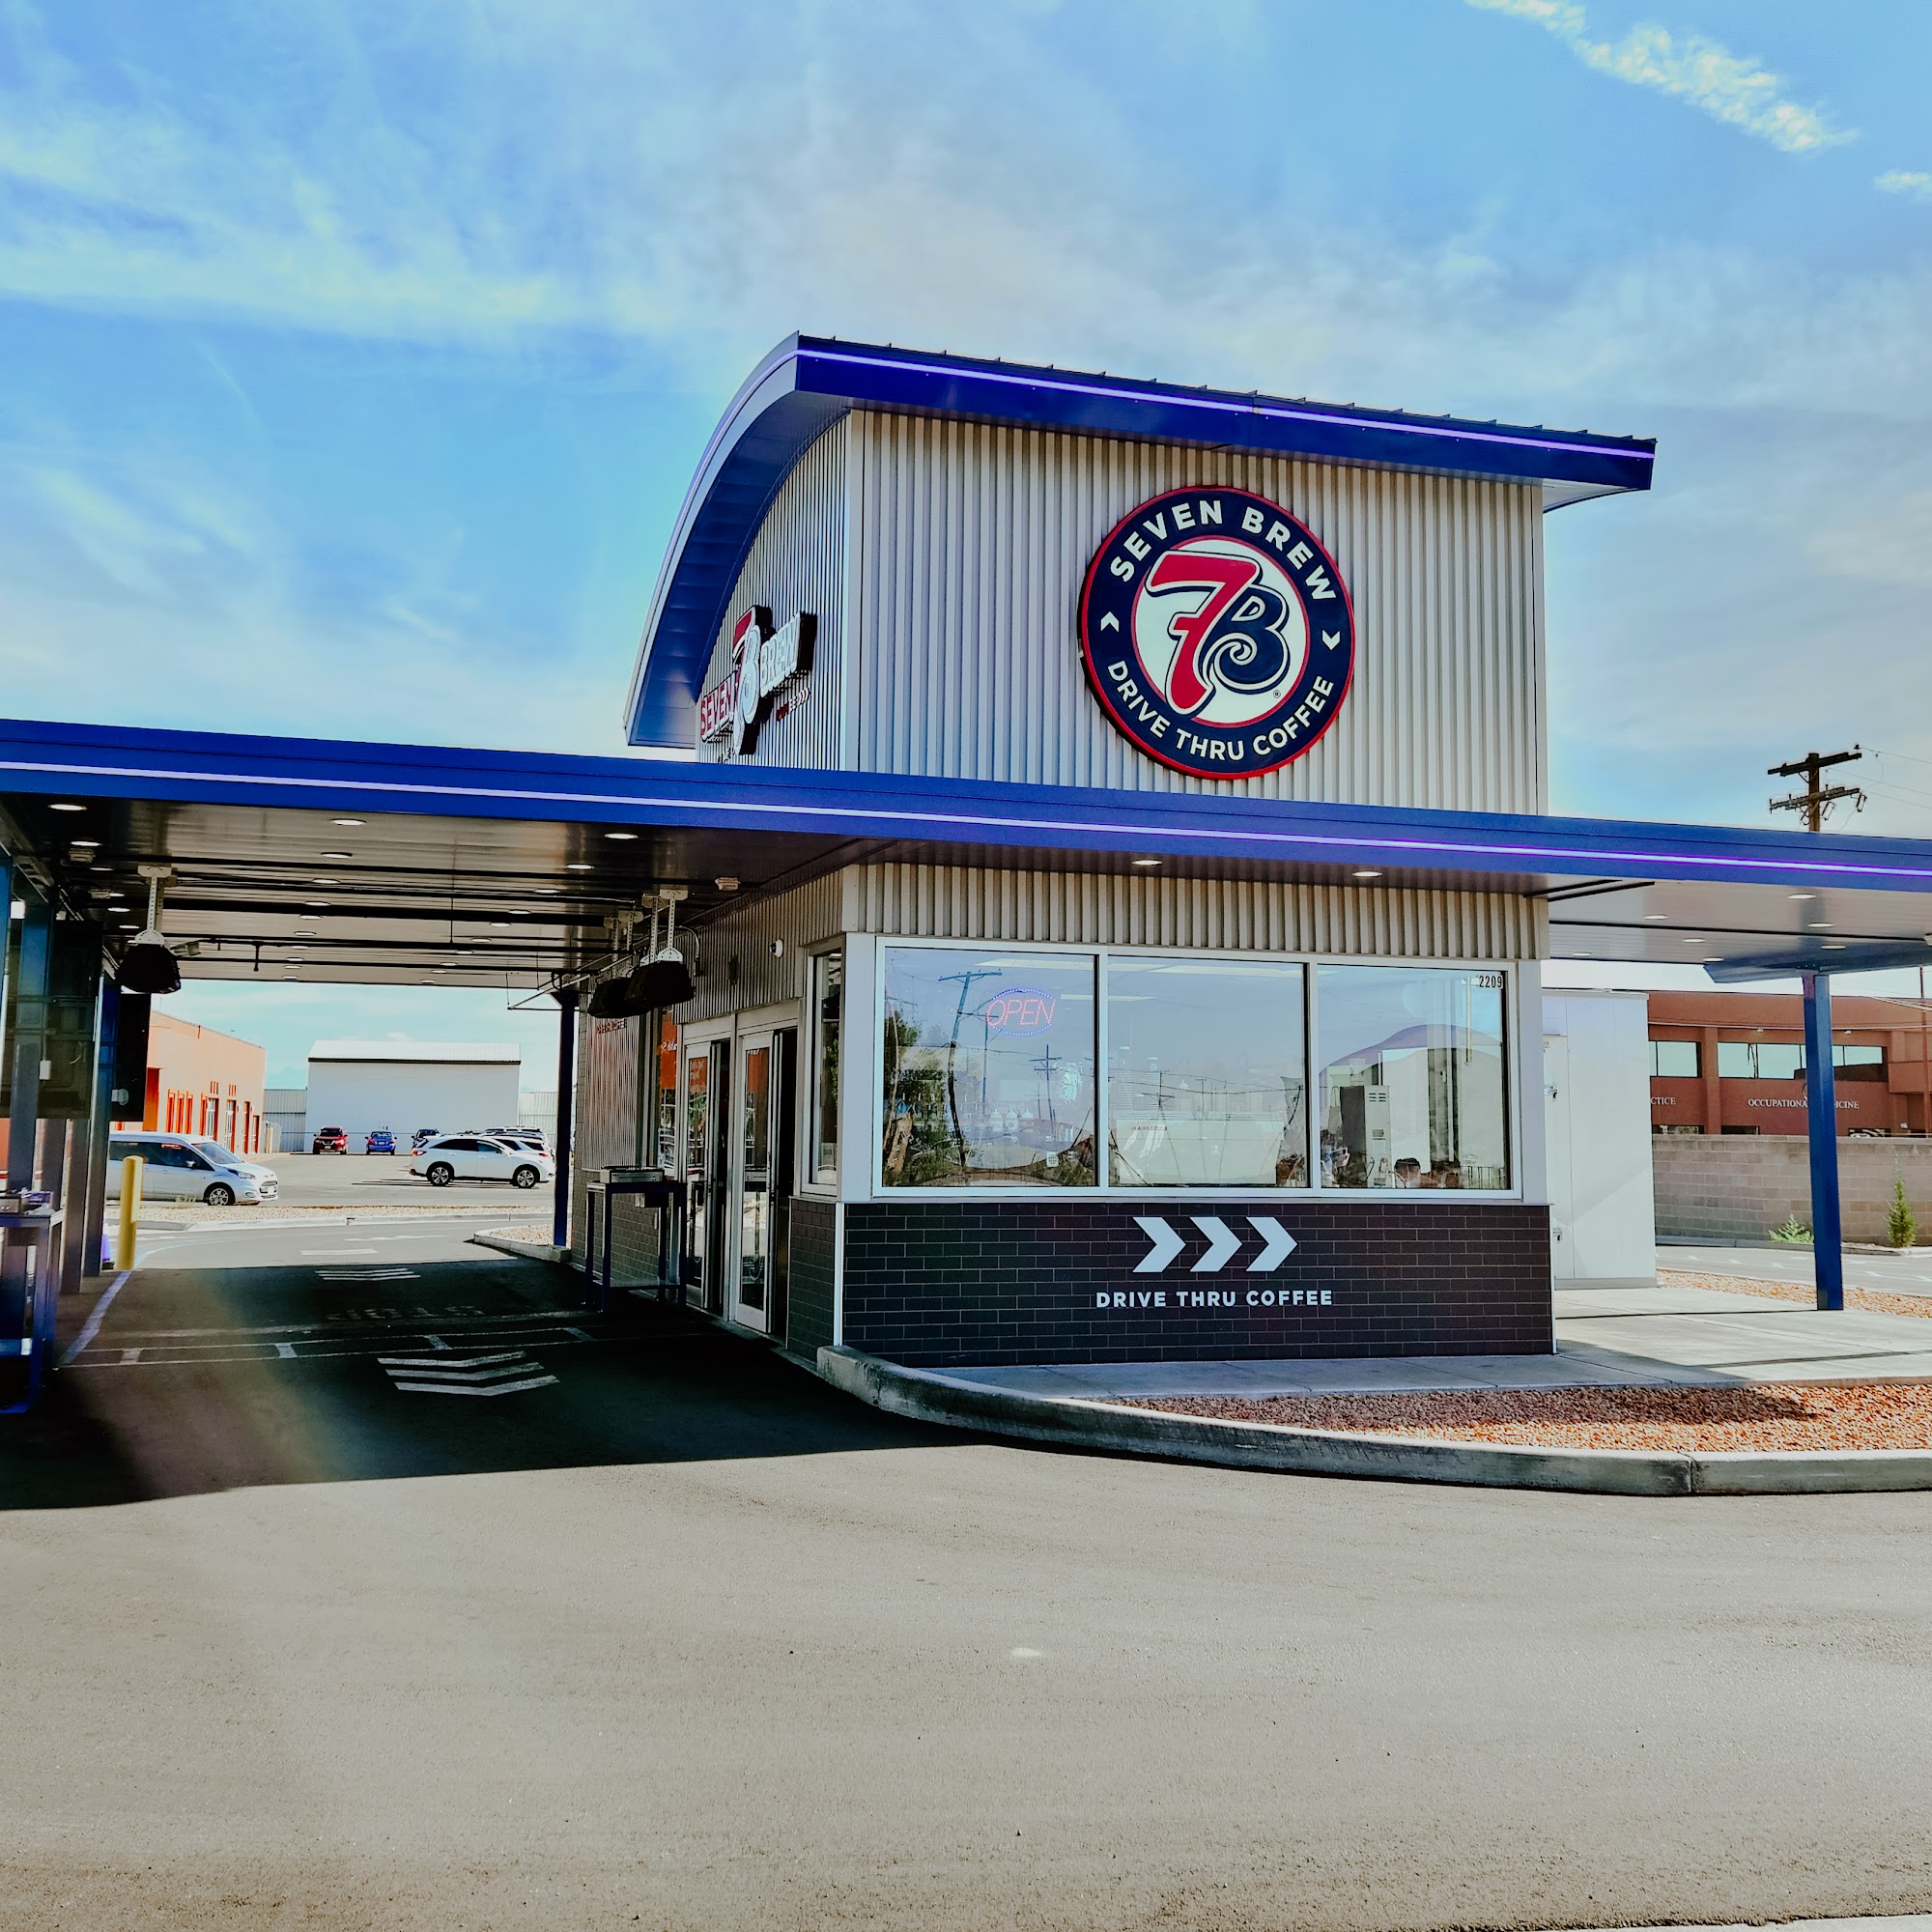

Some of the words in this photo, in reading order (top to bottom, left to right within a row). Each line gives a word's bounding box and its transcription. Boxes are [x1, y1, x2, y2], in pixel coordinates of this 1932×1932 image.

[1111, 499, 1223, 582] SEVEN
[1241, 506, 1337, 600] BREW
[700, 672, 735, 741] SEVEN
[759, 611, 800, 697] BREW
[1107, 661, 1171, 738] DRIVE
[1175, 727, 1245, 762] THRU
[1253, 675, 1335, 755] COFFEE
[1479, 975, 1503, 988] 2209
[985, 998, 1057, 1027] OPEN
[1650, 1096, 1676, 1105] CTICE
[1747, 1098, 1808, 1108] OCCUPATIONA
[1834, 1100, 1861, 1109] ICINE
[1096, 1292, 1167, 1308] DRIVE
[1176, 1291, 1236, 1307] THRU
[1245, 1290, 1332, 1306] COFFEE
